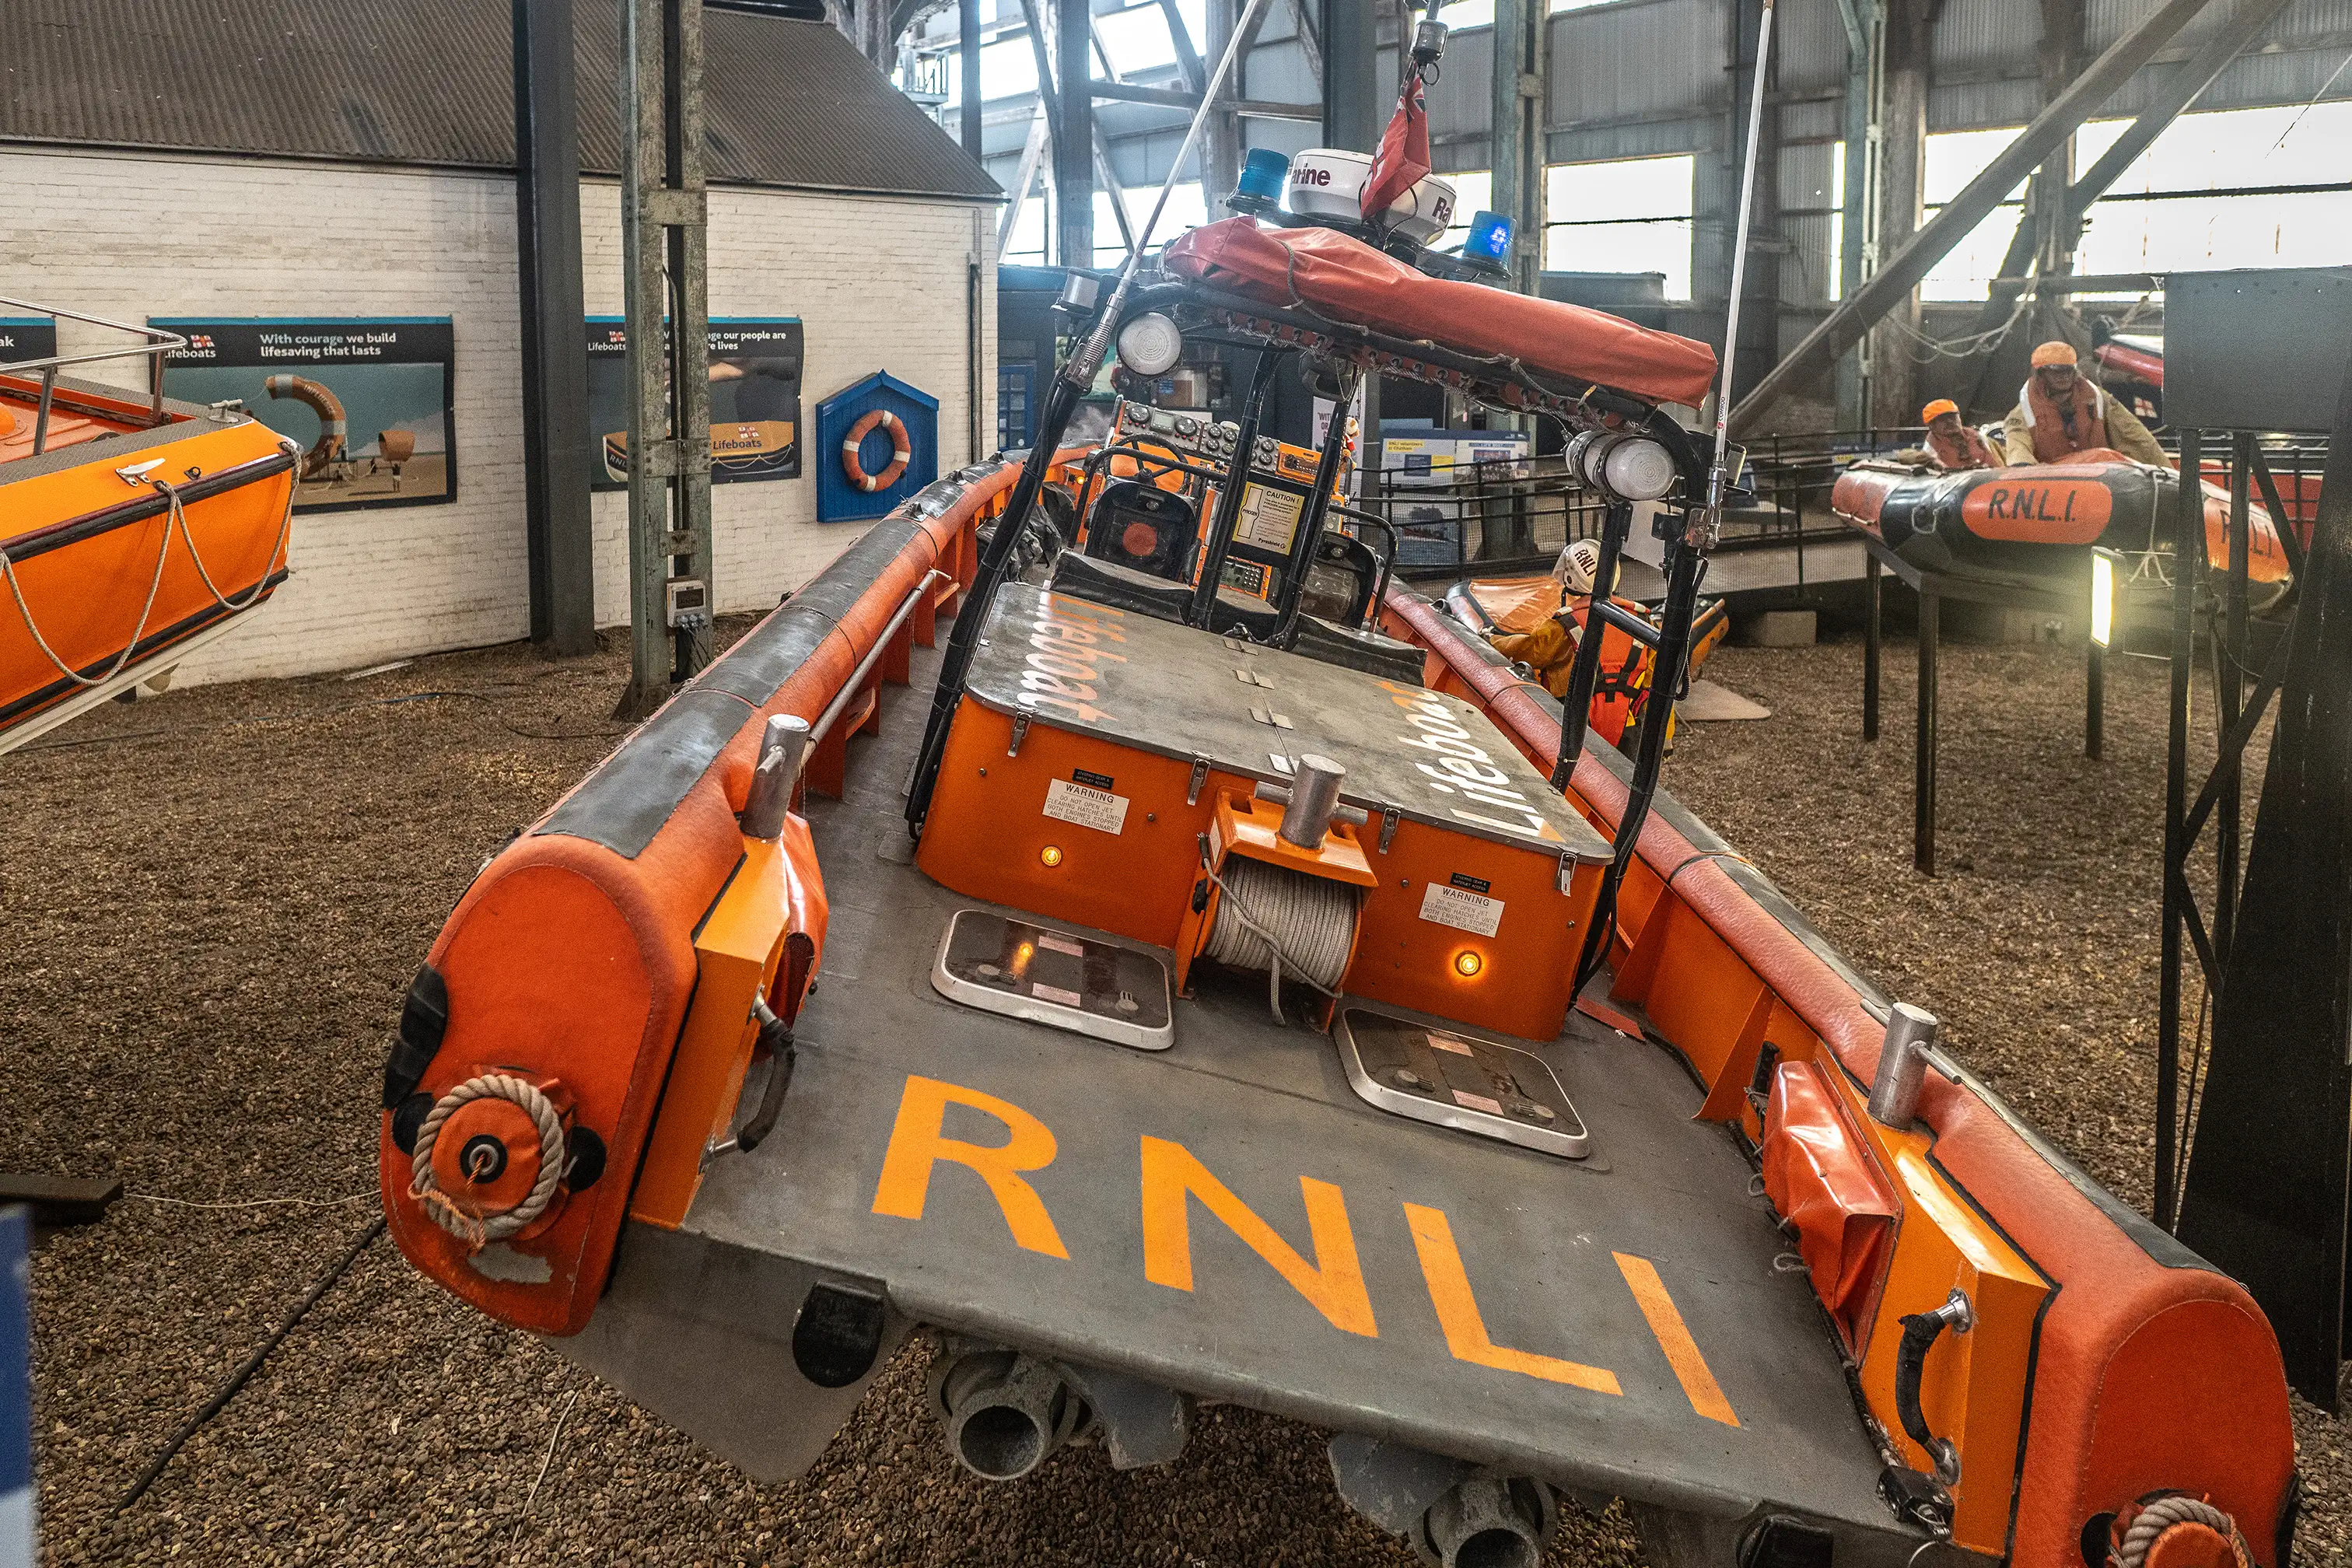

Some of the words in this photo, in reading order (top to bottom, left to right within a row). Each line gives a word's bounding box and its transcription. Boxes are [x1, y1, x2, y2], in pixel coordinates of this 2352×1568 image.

[260, 334, 292, 344] With
[295, 336, 343, 346] courage
[366, 332, 396, 342] build
[740, 331, 771, 341] people
[261, 345, 320, 359] lifesaving
[323, 345, 349, 355] that
[352, 345, 381, 355] lasts
[588, 342, 626, 351] Lifeboats
[718, 341, 739, 350] lives
[712, 439, 762, 450] Lifeboats
[1266, 490, 1295, 503] CAUTION
[1258, 537, 1280, 547] Pyroshield
[1574, 548, 1596, 576] RNLI
[1017, 591, 1128, 723] Lifeboat
[1374, 681, 1566, 843] Lifeboat
[1066, 784, 1114, 803] WARNING
[1048, 798, 1075, 810] CLEARING
[1078, 806, 1103, 817] HATCHES
[1066, 809, 1090, 820] ENGINES
[1094, 817, 1118, 827] STOPPED
[1081, 819, 1115, 832] STATIONARY
[1443, 887, 1490, 906] WARNING
[1424, 901, 1451, 912] CLEARING
[1454, 909, 1480, 920] HATCHES
[1442, 912, 1466, 922] ENGINES
[1469, 919, 1493, 929] STOPPED
[1456, 922, 1490, 935] STATIONARY
[871, 1075, 1741, 1428] RNLI
